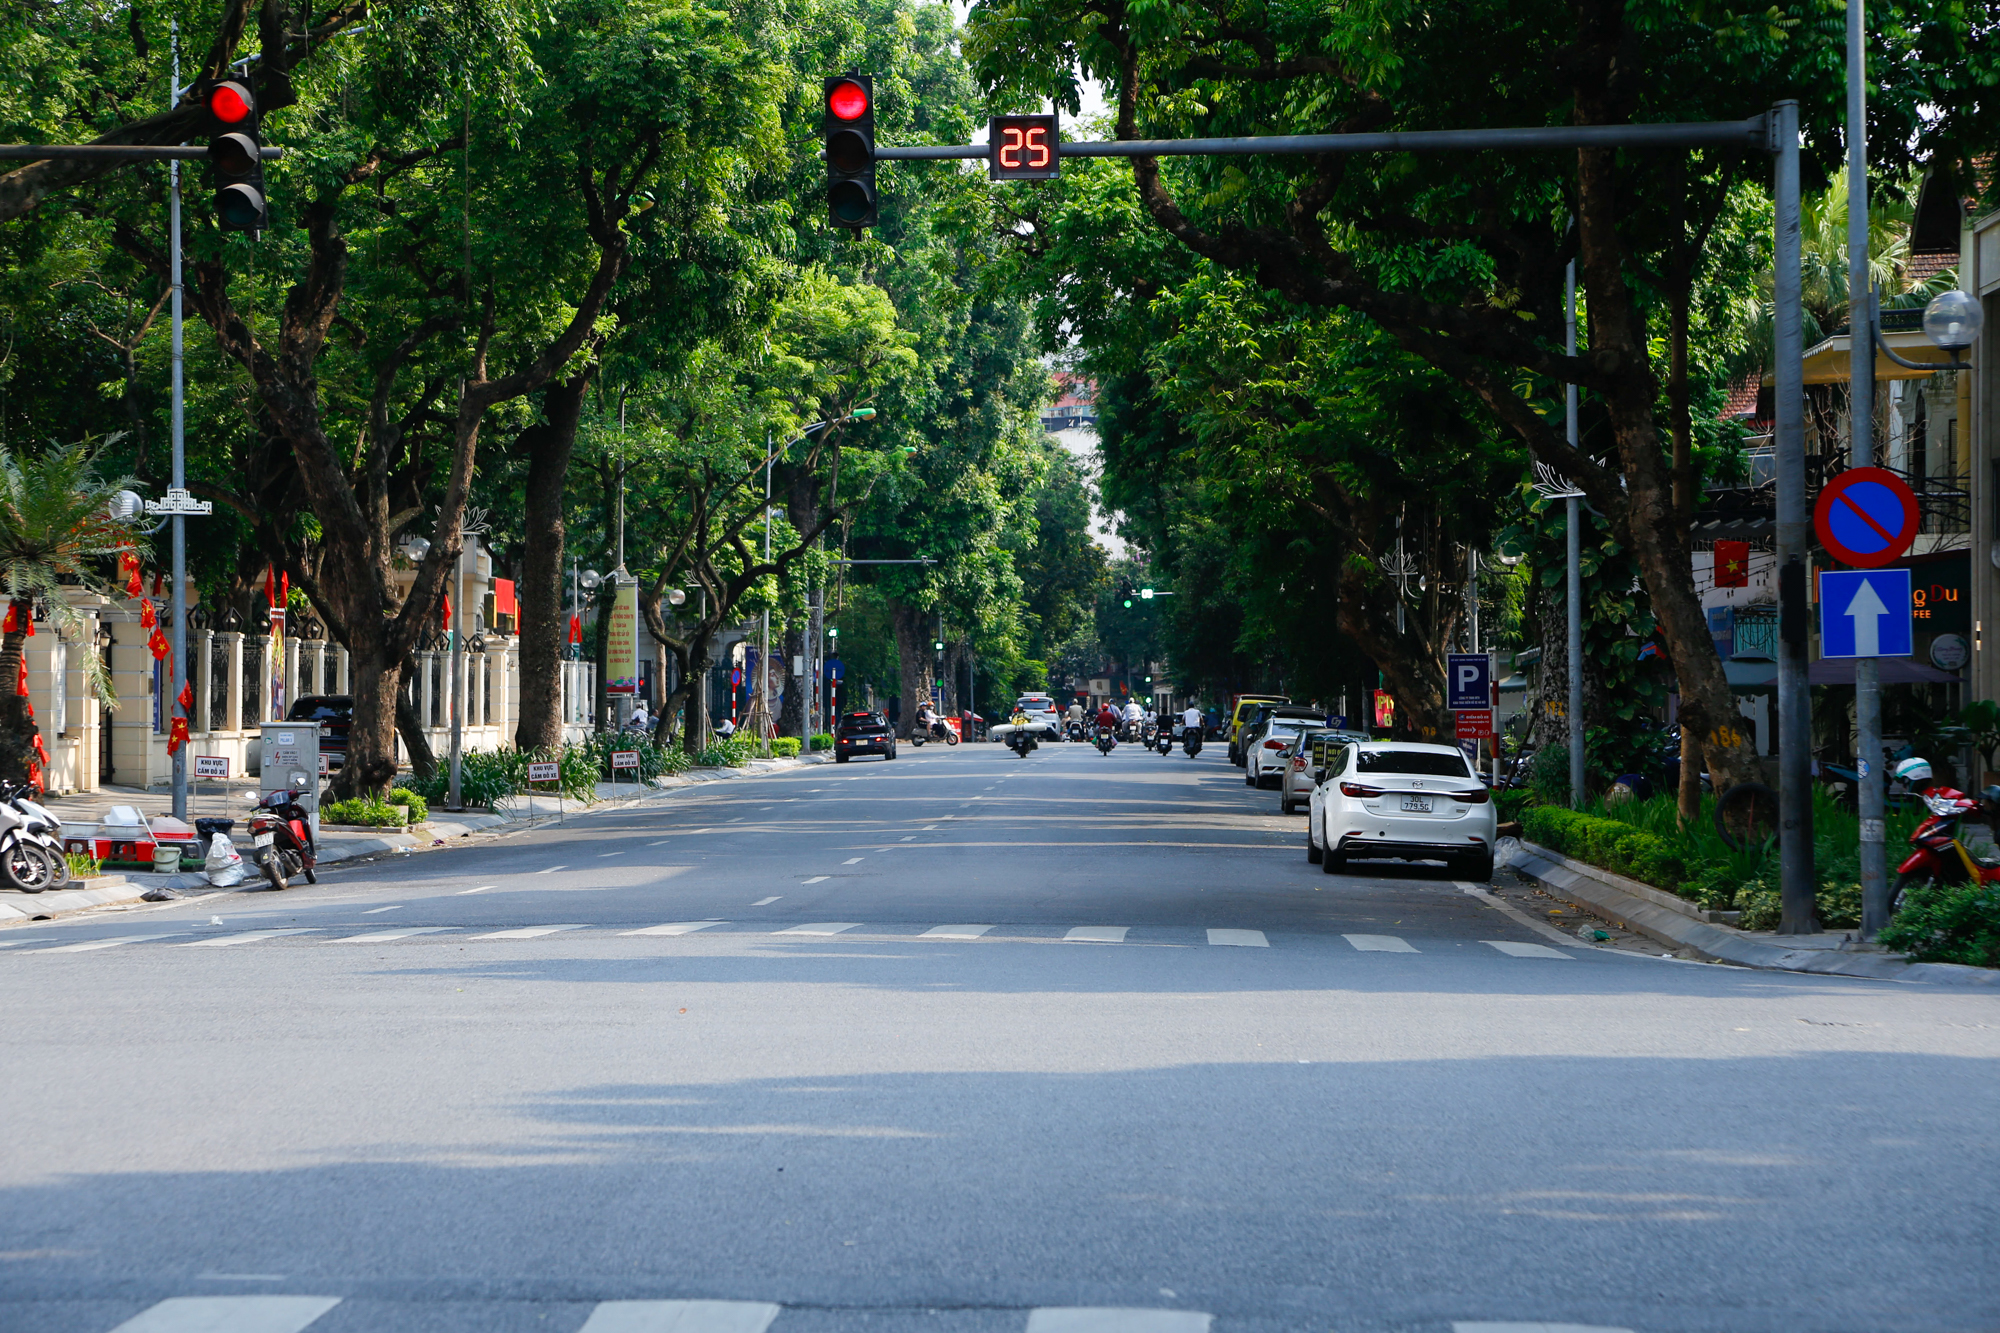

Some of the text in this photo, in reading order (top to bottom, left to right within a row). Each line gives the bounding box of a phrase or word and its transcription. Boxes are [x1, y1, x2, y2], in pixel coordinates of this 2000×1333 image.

[1000, 127, 1050, 167] 25
[1458, 665, 1479, 692] P
[1331, 717, 1342, 727] G7
